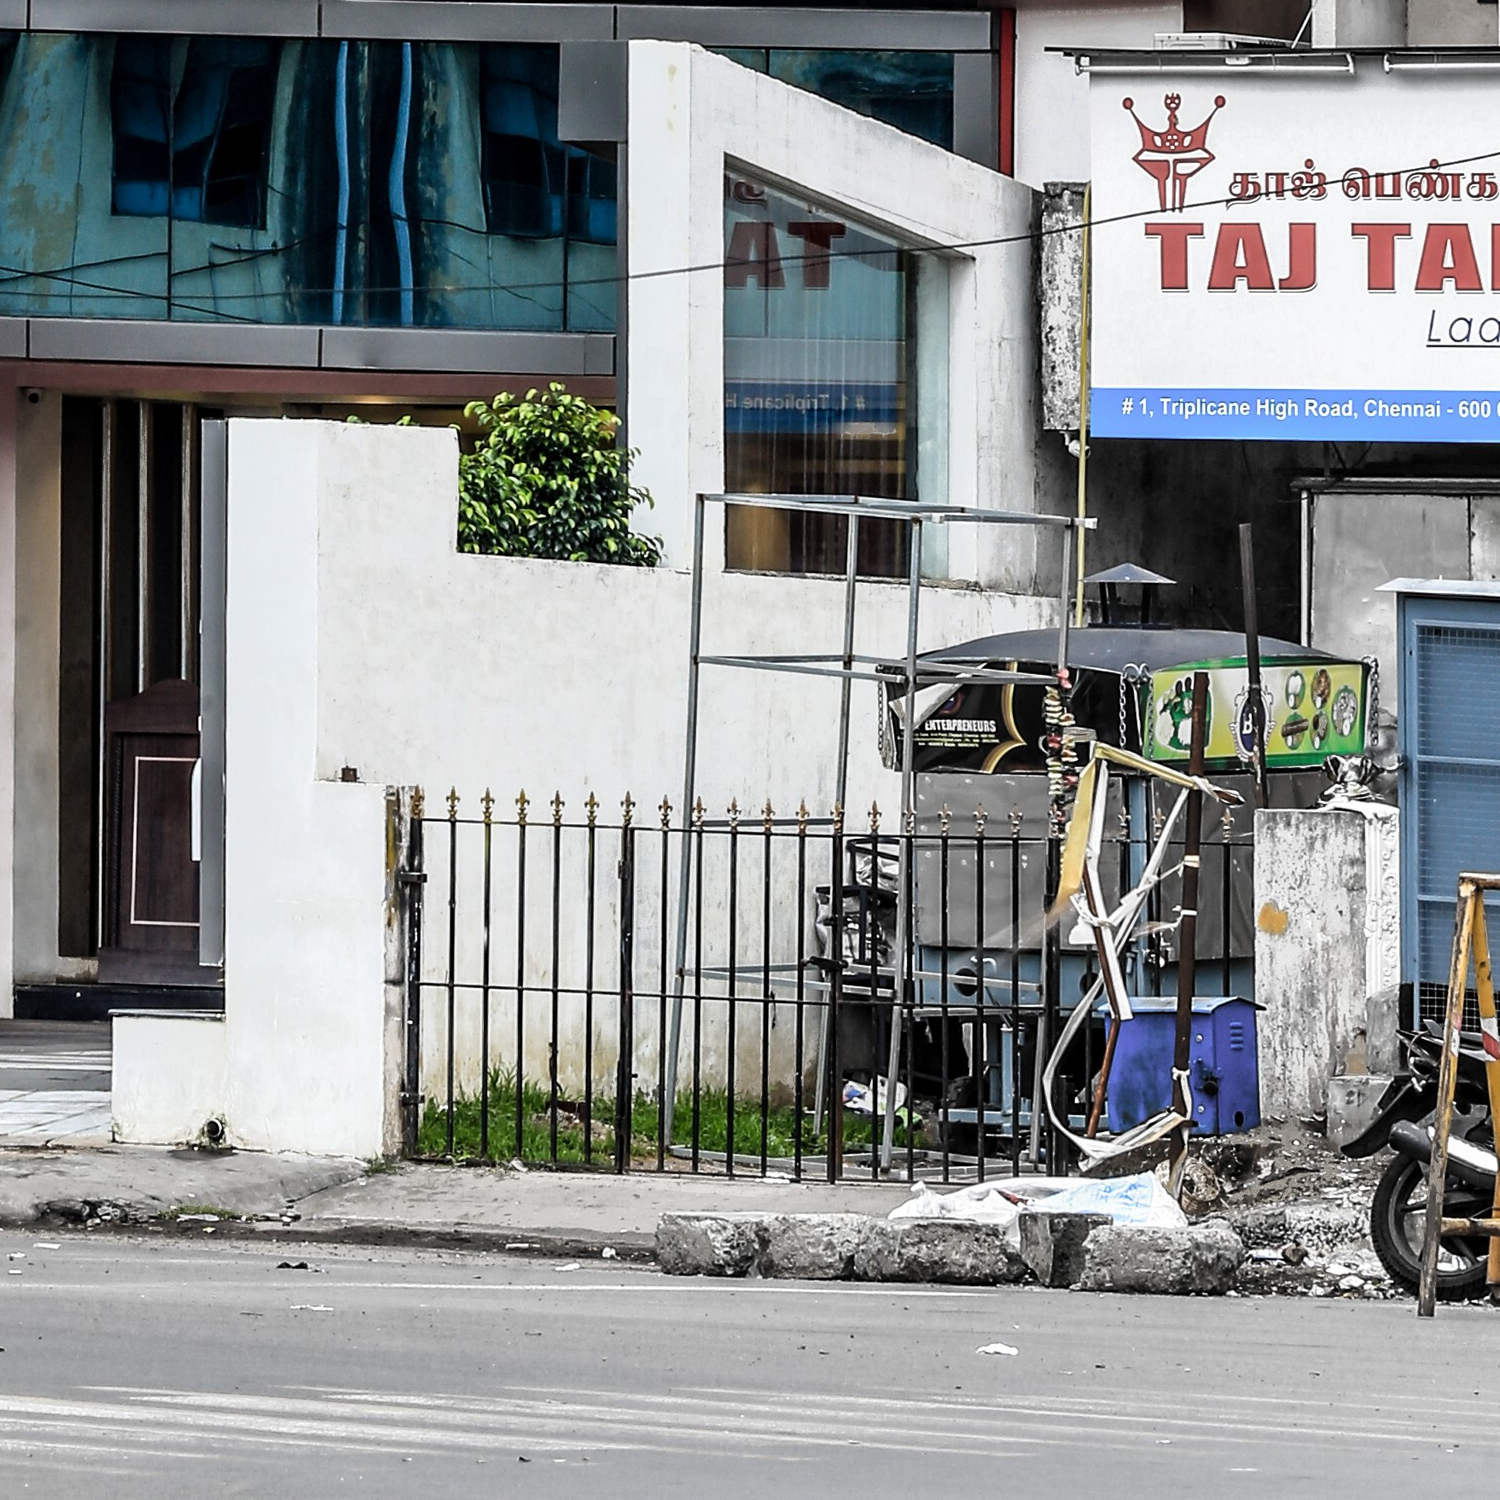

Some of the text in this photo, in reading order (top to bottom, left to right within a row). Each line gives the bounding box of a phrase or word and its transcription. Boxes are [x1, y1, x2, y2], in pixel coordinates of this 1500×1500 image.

[1144, 222, 1500, 293] TAJ TA
[1121, 397, 1134, 415] #
[1140, 398, 1154, 418] 1,
[1160, 397, 1250, 419] Triplicane
[1256, 399, 1299, 420] High
[1305, 399, 1358, 419] Road,
[1364, 400, 1441, 418] Chennai
[1458, 401, 1491, 418] 600
